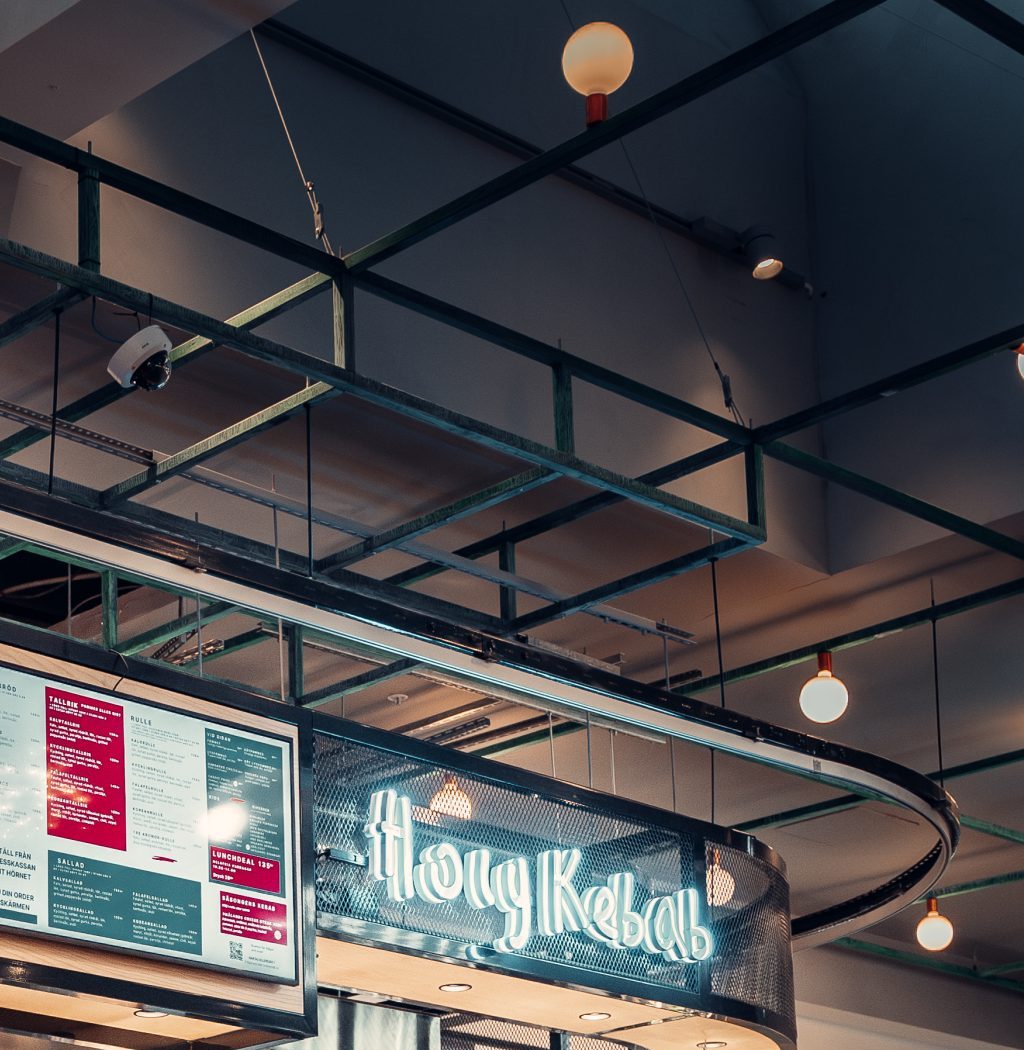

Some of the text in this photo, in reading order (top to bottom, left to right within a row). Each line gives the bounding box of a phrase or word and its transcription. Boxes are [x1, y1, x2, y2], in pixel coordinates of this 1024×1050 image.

[49, 695, 78, 708] TALLRIK
[130, 715, 151, 725] RULLE
[15, 849, 31, 859] FRÅN
[212, 850, 254, 865] LUNCHDEAL
[57, 857, 84, 868] SALLAD
[6, 869, 31, 880] HÖRNET
[14, 891, 34, 901] ORDER
[0, 898, 29, 910] SKÄRMEN
[536, 847, 714, 965] Kebab
